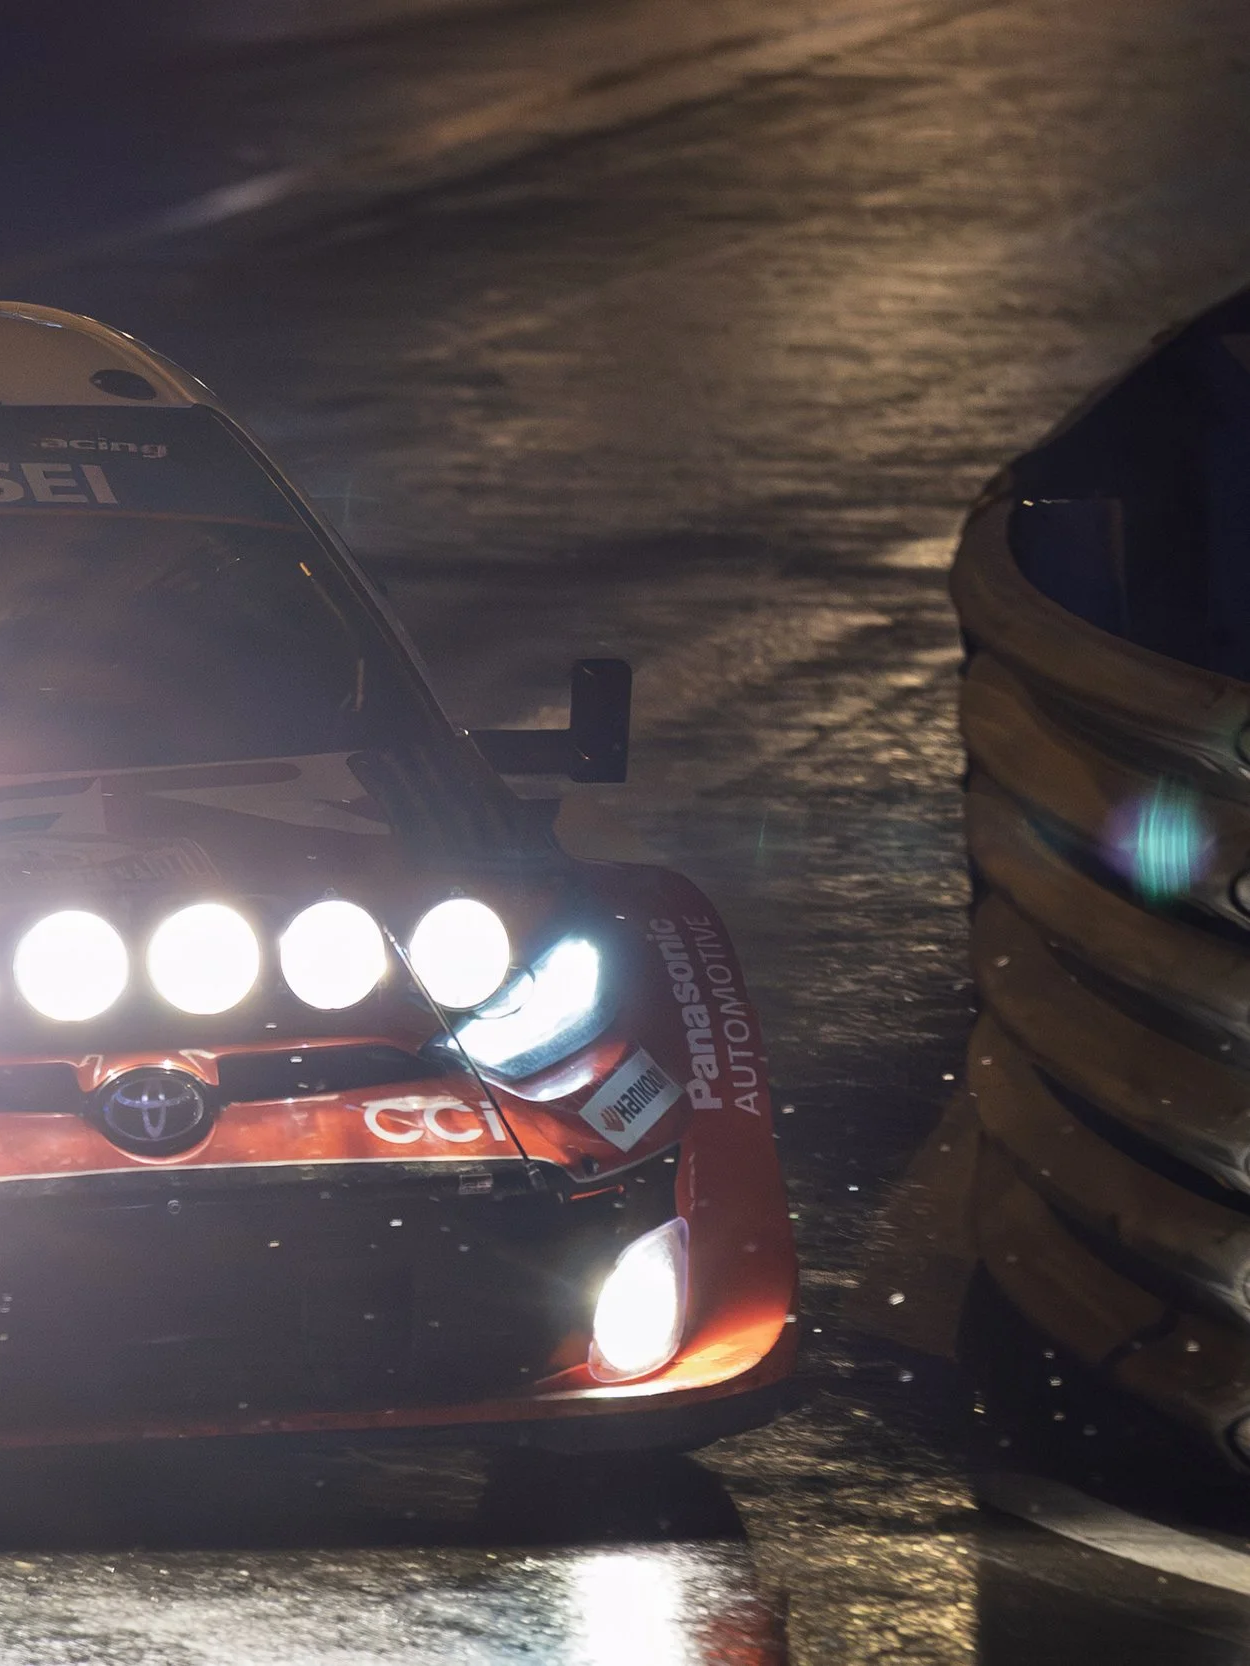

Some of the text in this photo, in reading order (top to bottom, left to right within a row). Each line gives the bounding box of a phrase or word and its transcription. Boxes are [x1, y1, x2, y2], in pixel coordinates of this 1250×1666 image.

[32, 435, 169, 459] acing
[646, 918, 723, 1111] Panasonic
[682, 915, 762, 1117] AUTOMOTIVE
